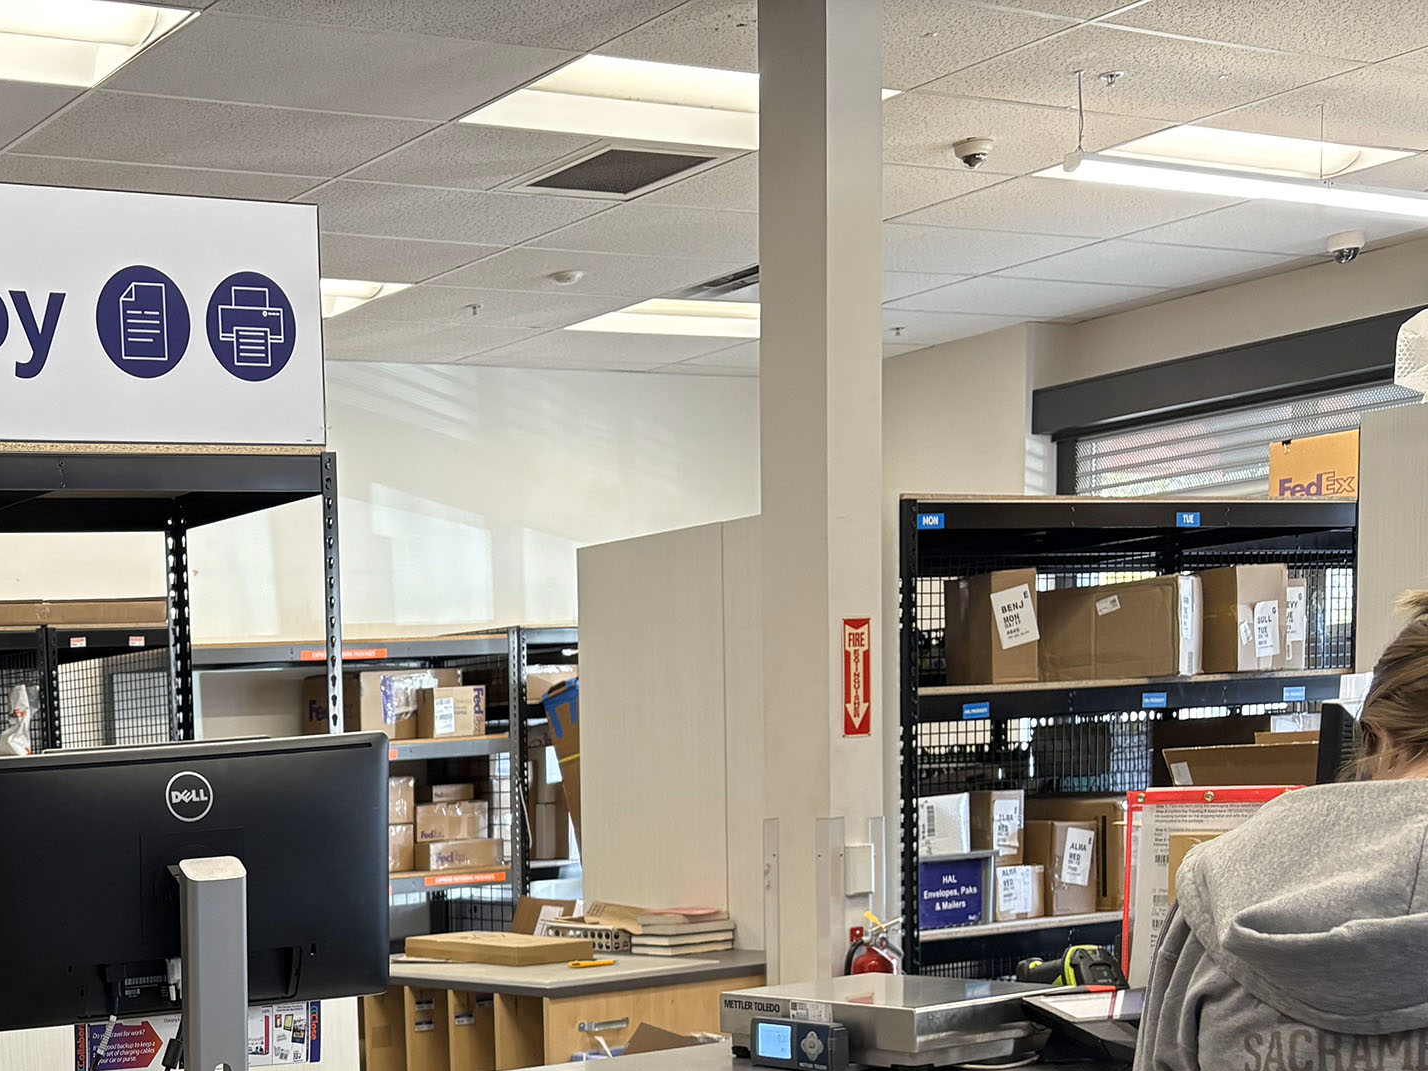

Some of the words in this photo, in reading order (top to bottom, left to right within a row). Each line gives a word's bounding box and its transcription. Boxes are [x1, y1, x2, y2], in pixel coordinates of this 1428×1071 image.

[1278, 470, 1355, 498] FedEx
[922, 515, 939, 526] MON
[1182, 514, 1196, 525] TUE
[1001, 601, 1025, 614] BENJ
[1003, 613, 1020, 624] MON
[848, 632, 865, 648] FIRE
[171, 788, 208, 805] DELL
[942, 874, 958, 884] HAL
[923, 887, 959, 900] Envelopes,
[960, 885, 978, 895] Paks
[935, 903, 941, 911] &
[941, 901, 966, 911] Mailers
[724, 1000, 752, 1010] METTLER
[754, 1002, 780, 1013] TOLEDO
